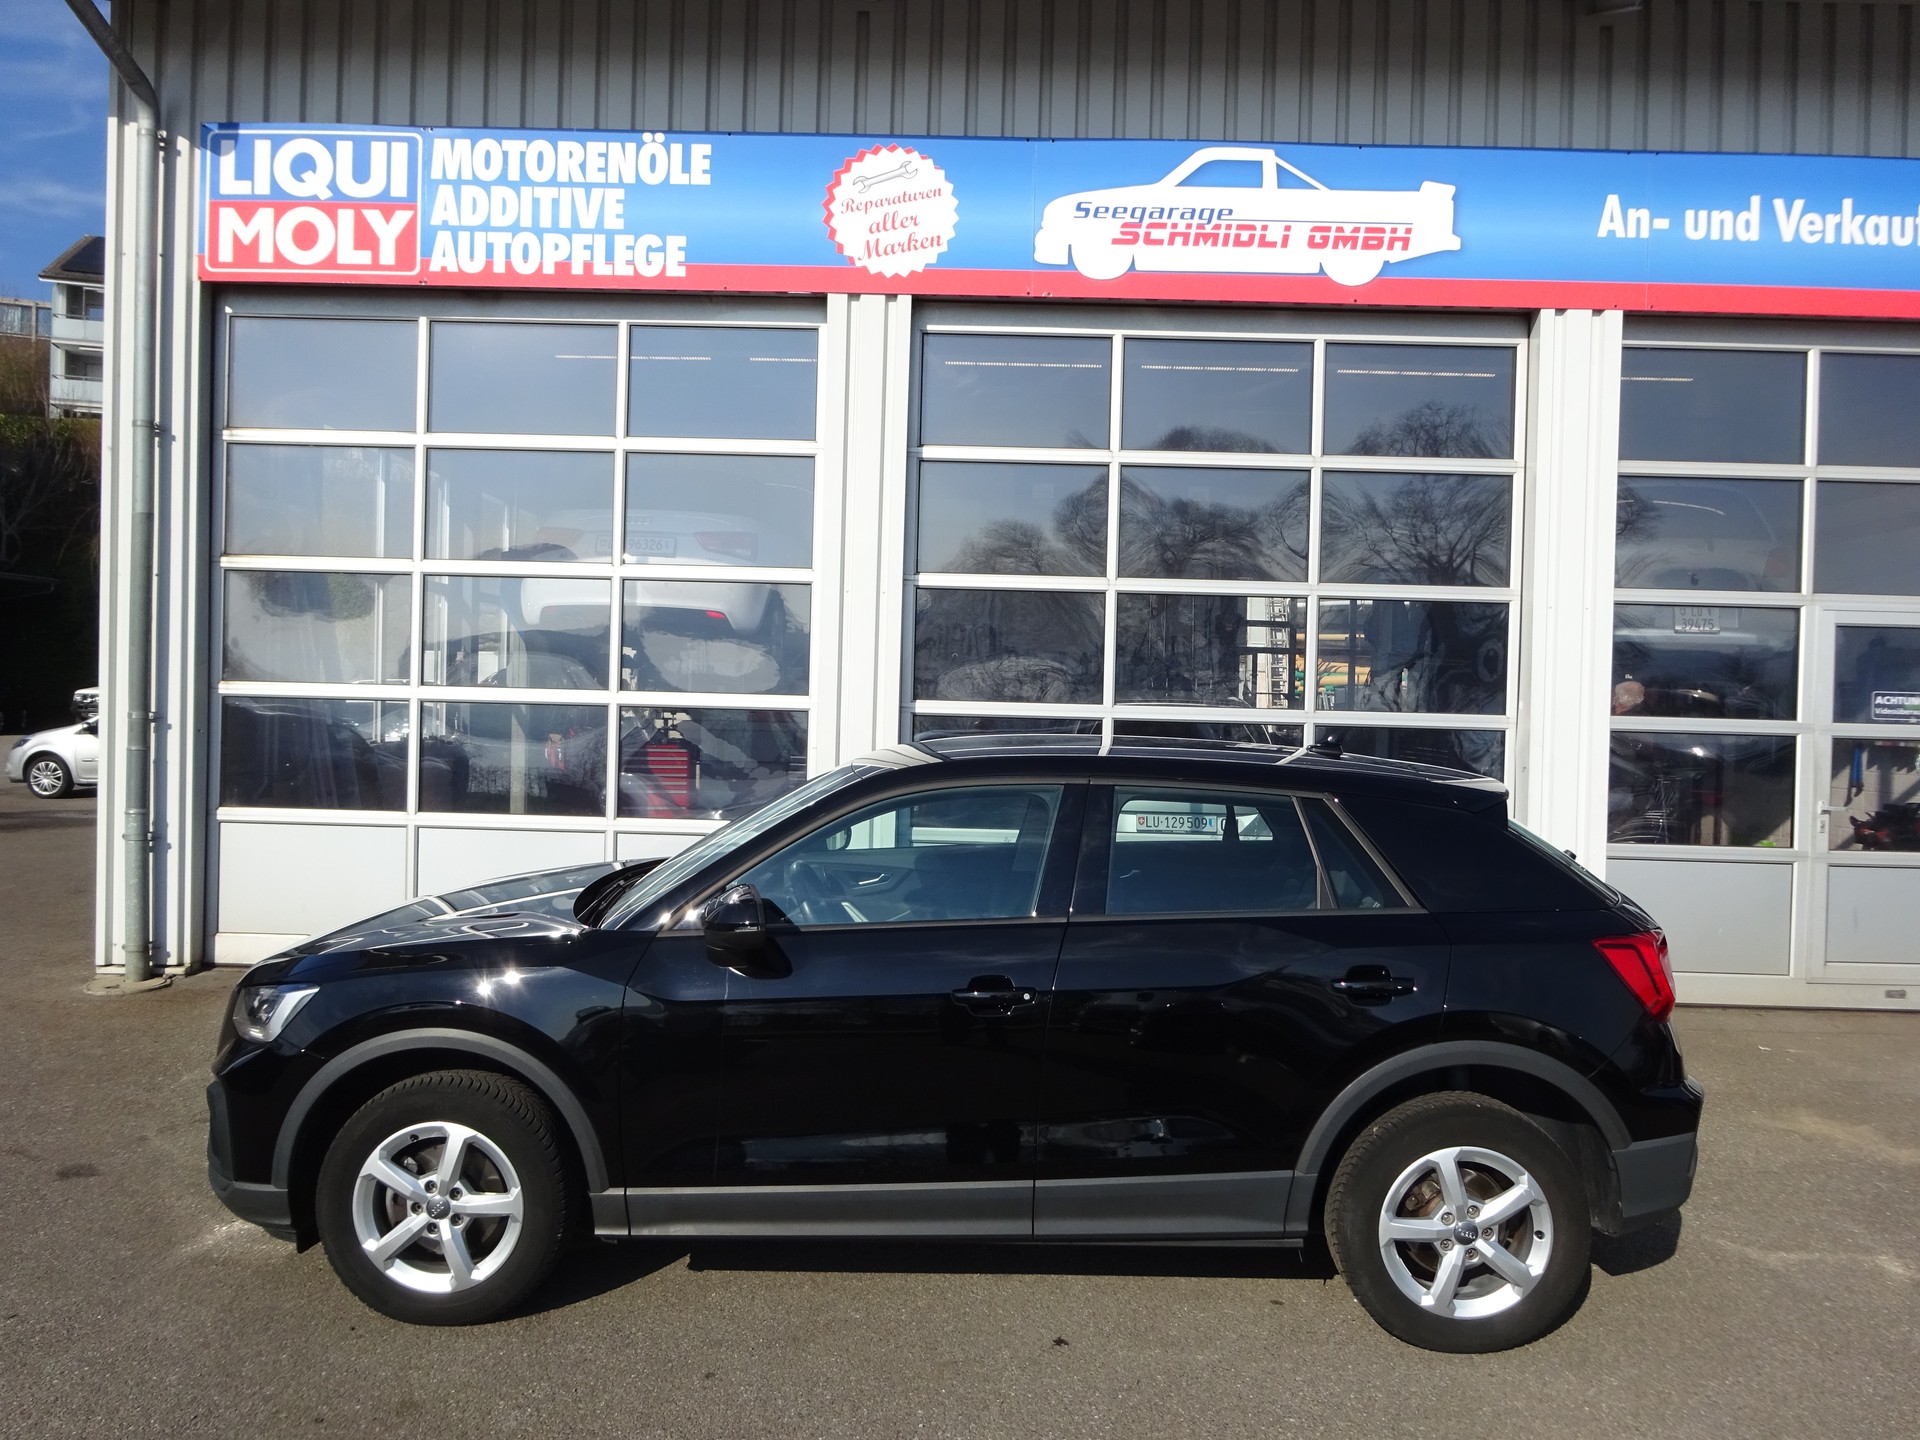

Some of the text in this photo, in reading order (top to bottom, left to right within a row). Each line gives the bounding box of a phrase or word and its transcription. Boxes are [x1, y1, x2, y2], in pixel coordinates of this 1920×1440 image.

[219, 138, 408, 200] LIQUI
[430, 132, 712, 186] MOTORENÖLE
[430, 185, 625, 230] ADDITIVE
[840, 187, 943, 215] Reparaturen
[868, 210, 921, 235] aller
[1074, 201, 1234, 225] Seegarage
[1597, 194, 1670, 239] An-
[1684, 194, 1761, 242] und
[218, 206, 415, 265] MOLY
[429, 230, 687, 277] AUTOPFLEGE
[857, 231, 944, 261] Marken
[1111, 222, 1413, 252] SCHMIDLI GMBH
